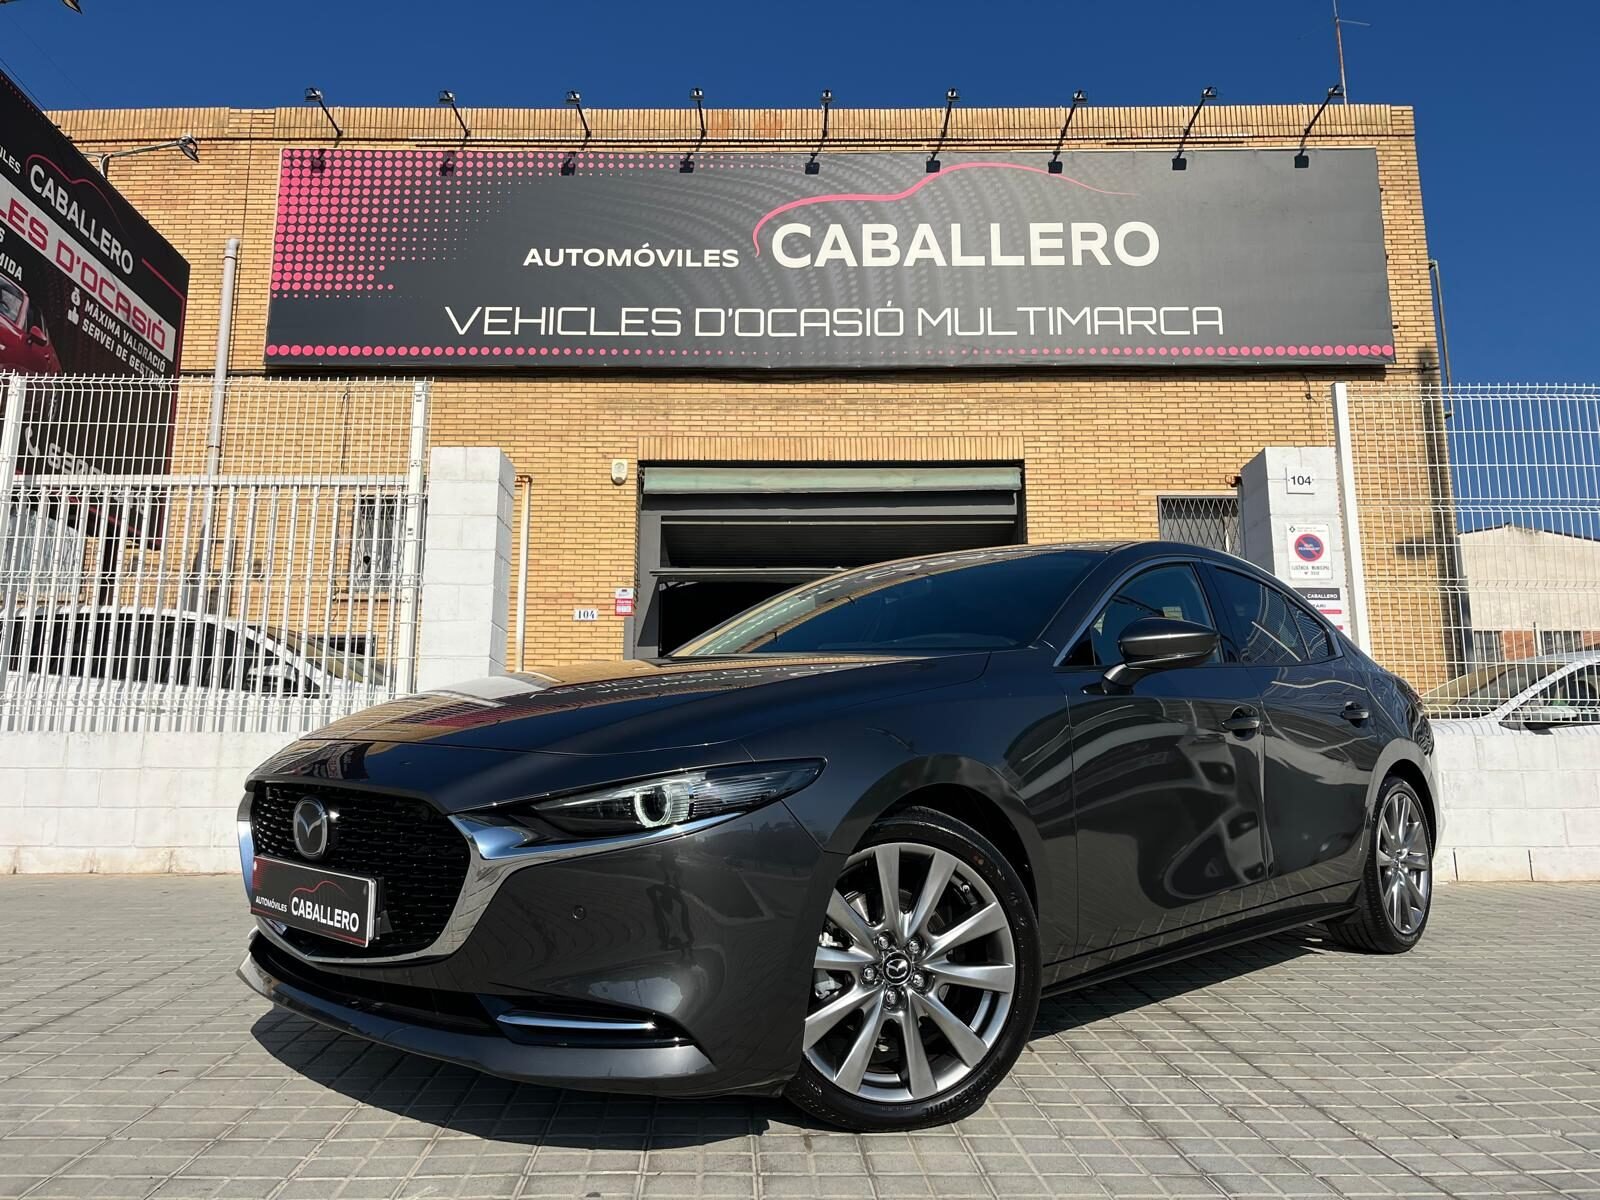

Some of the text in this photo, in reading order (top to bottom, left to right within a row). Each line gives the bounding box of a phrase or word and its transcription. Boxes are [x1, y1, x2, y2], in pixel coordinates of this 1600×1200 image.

[31, 164, 134, 275] CABALLERO
[523, 221, 1160, 269] AUTOMÓVILES CABALLERO
[56, 239, 166, 351] D'OCASIÓ
[82, 318, 115, 352] SERVEI
[115, 344, 128, 362] DE
[84, 299, 166, 373] MÀXIMA VALORACIÓ
[445, 300, 1224, 337] VEHICLES D'OCASIÓ MULTIMARCA
[1290, 475, 1312, 486] 104
[578, 610, 595, 619] 104
[255, 895, 360, 933] AUTOMÓVILES CABALLERO
